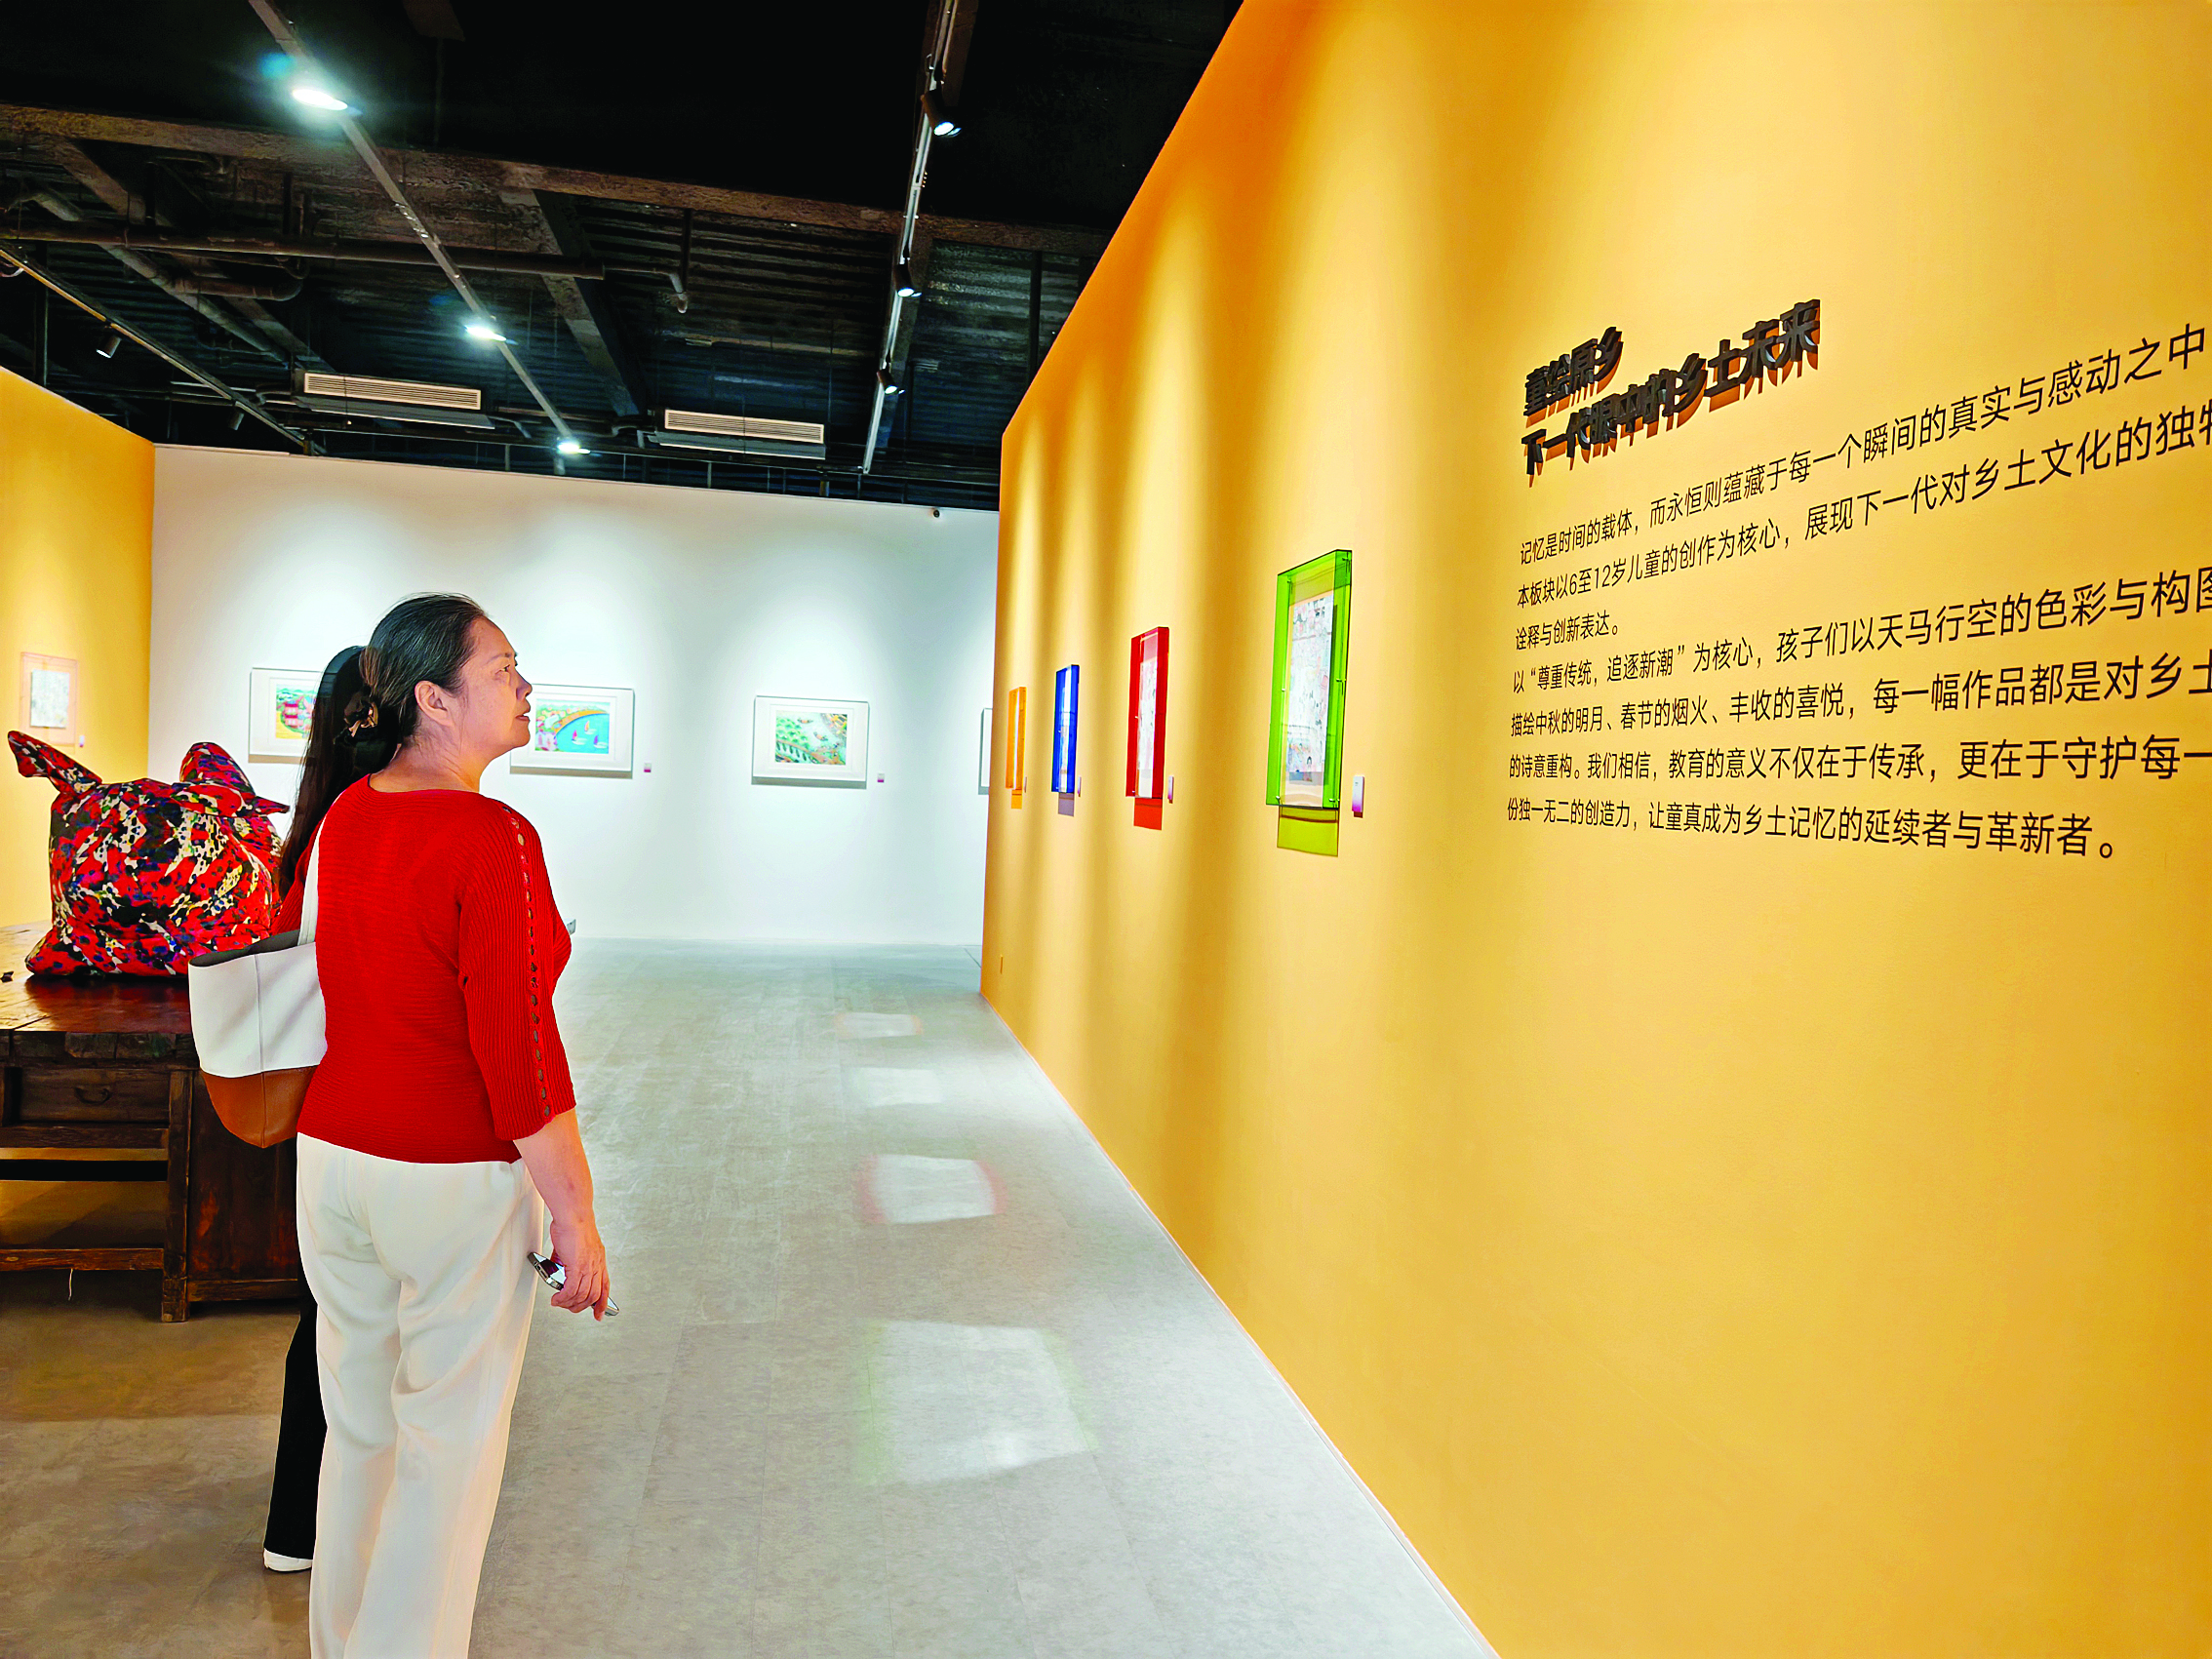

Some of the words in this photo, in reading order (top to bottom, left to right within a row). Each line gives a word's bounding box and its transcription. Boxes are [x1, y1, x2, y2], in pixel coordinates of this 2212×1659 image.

[1521, 299, 1820, 475] 下一代眼中的乡土未来
[1523, 327, 1624, 416] 重绘原乡
[1520, 323, 2204, 566] 记忆是时间的载体，而永恒则蕴藏于每一个瞬间的真实与感动之中
[1515, 610, 1619, 651] 诠释与创新表达。
[1509, 734, 2212, 782] 的诗意重构。我们相信，教育的意义不仅在于传承，更在于守护每一
[1507, 797, 2113, 858] 份独一无二的创造力，让童真成为乡土记忆的延续者与革新者。
